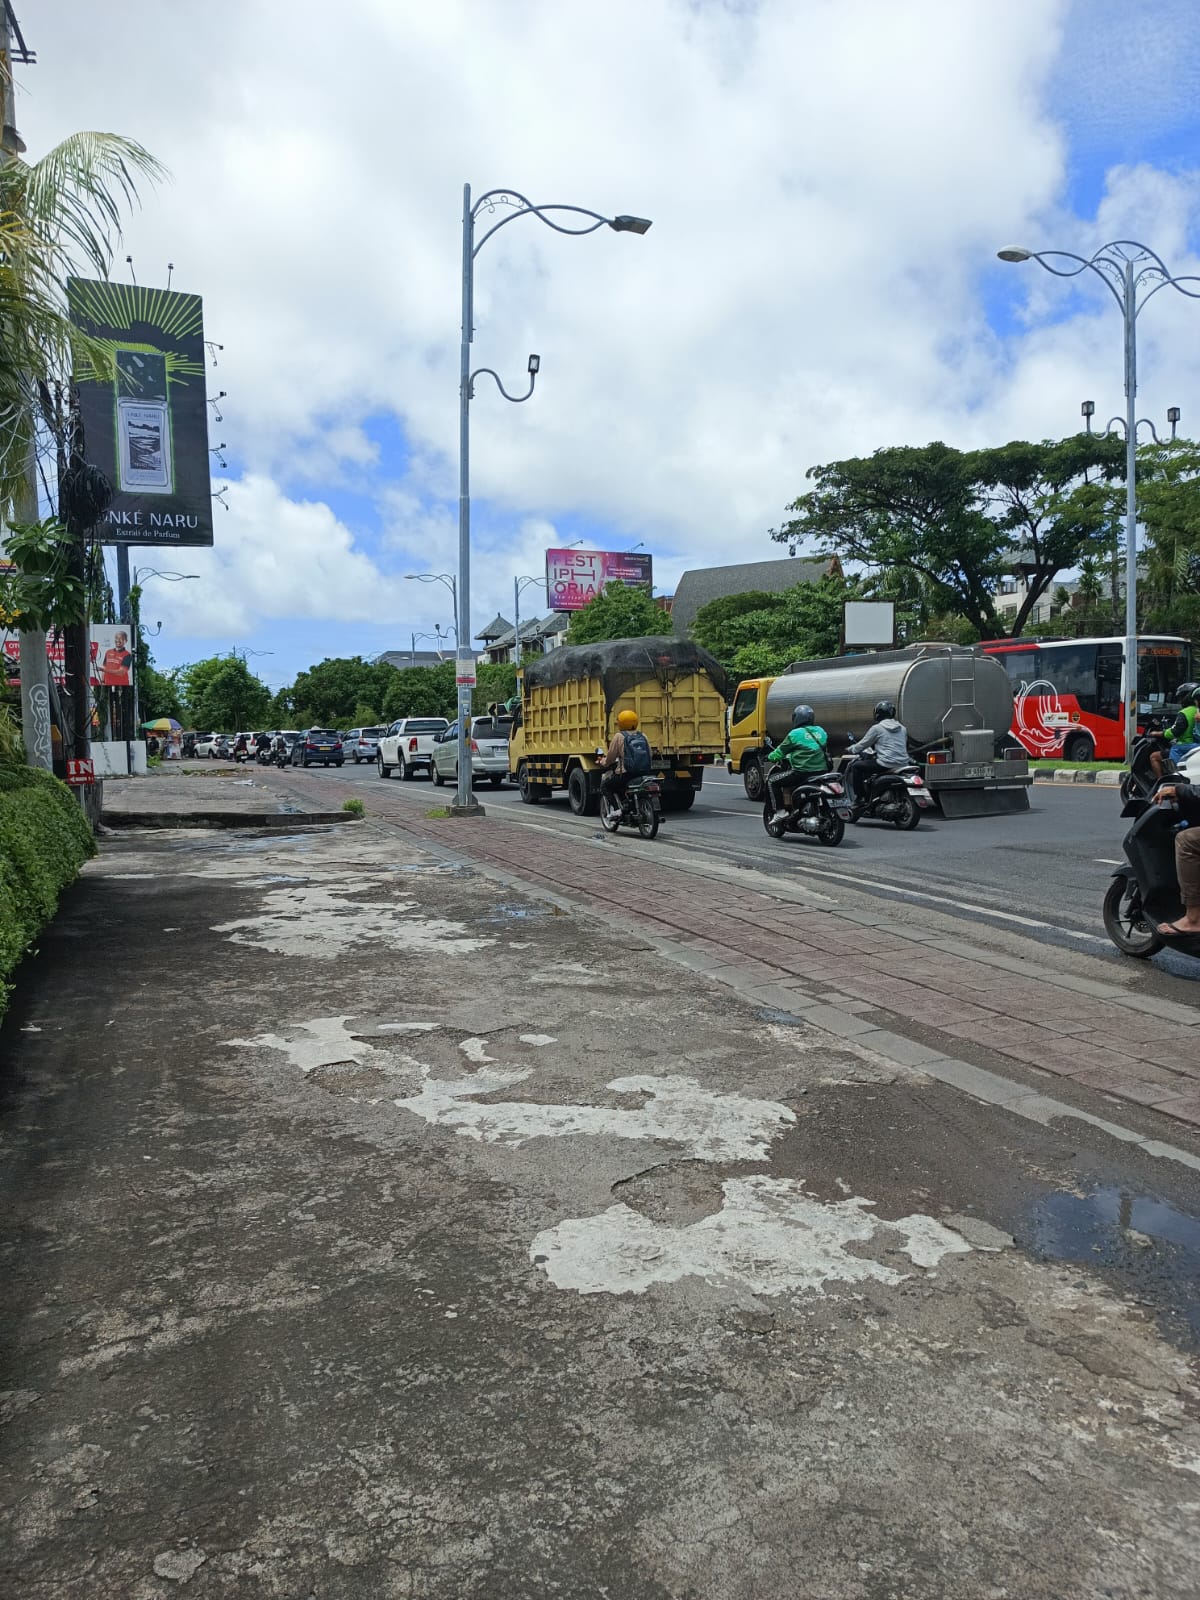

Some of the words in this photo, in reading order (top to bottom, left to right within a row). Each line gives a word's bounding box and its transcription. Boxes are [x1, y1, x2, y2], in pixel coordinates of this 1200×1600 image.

[150, 513, 198, 528] NARU
[143, 529, 152, 537] de
[154, 530, 180, 539] Parfum
[554, 582, 595, 595] ORIA
[68, 761, 92, 774] IN
